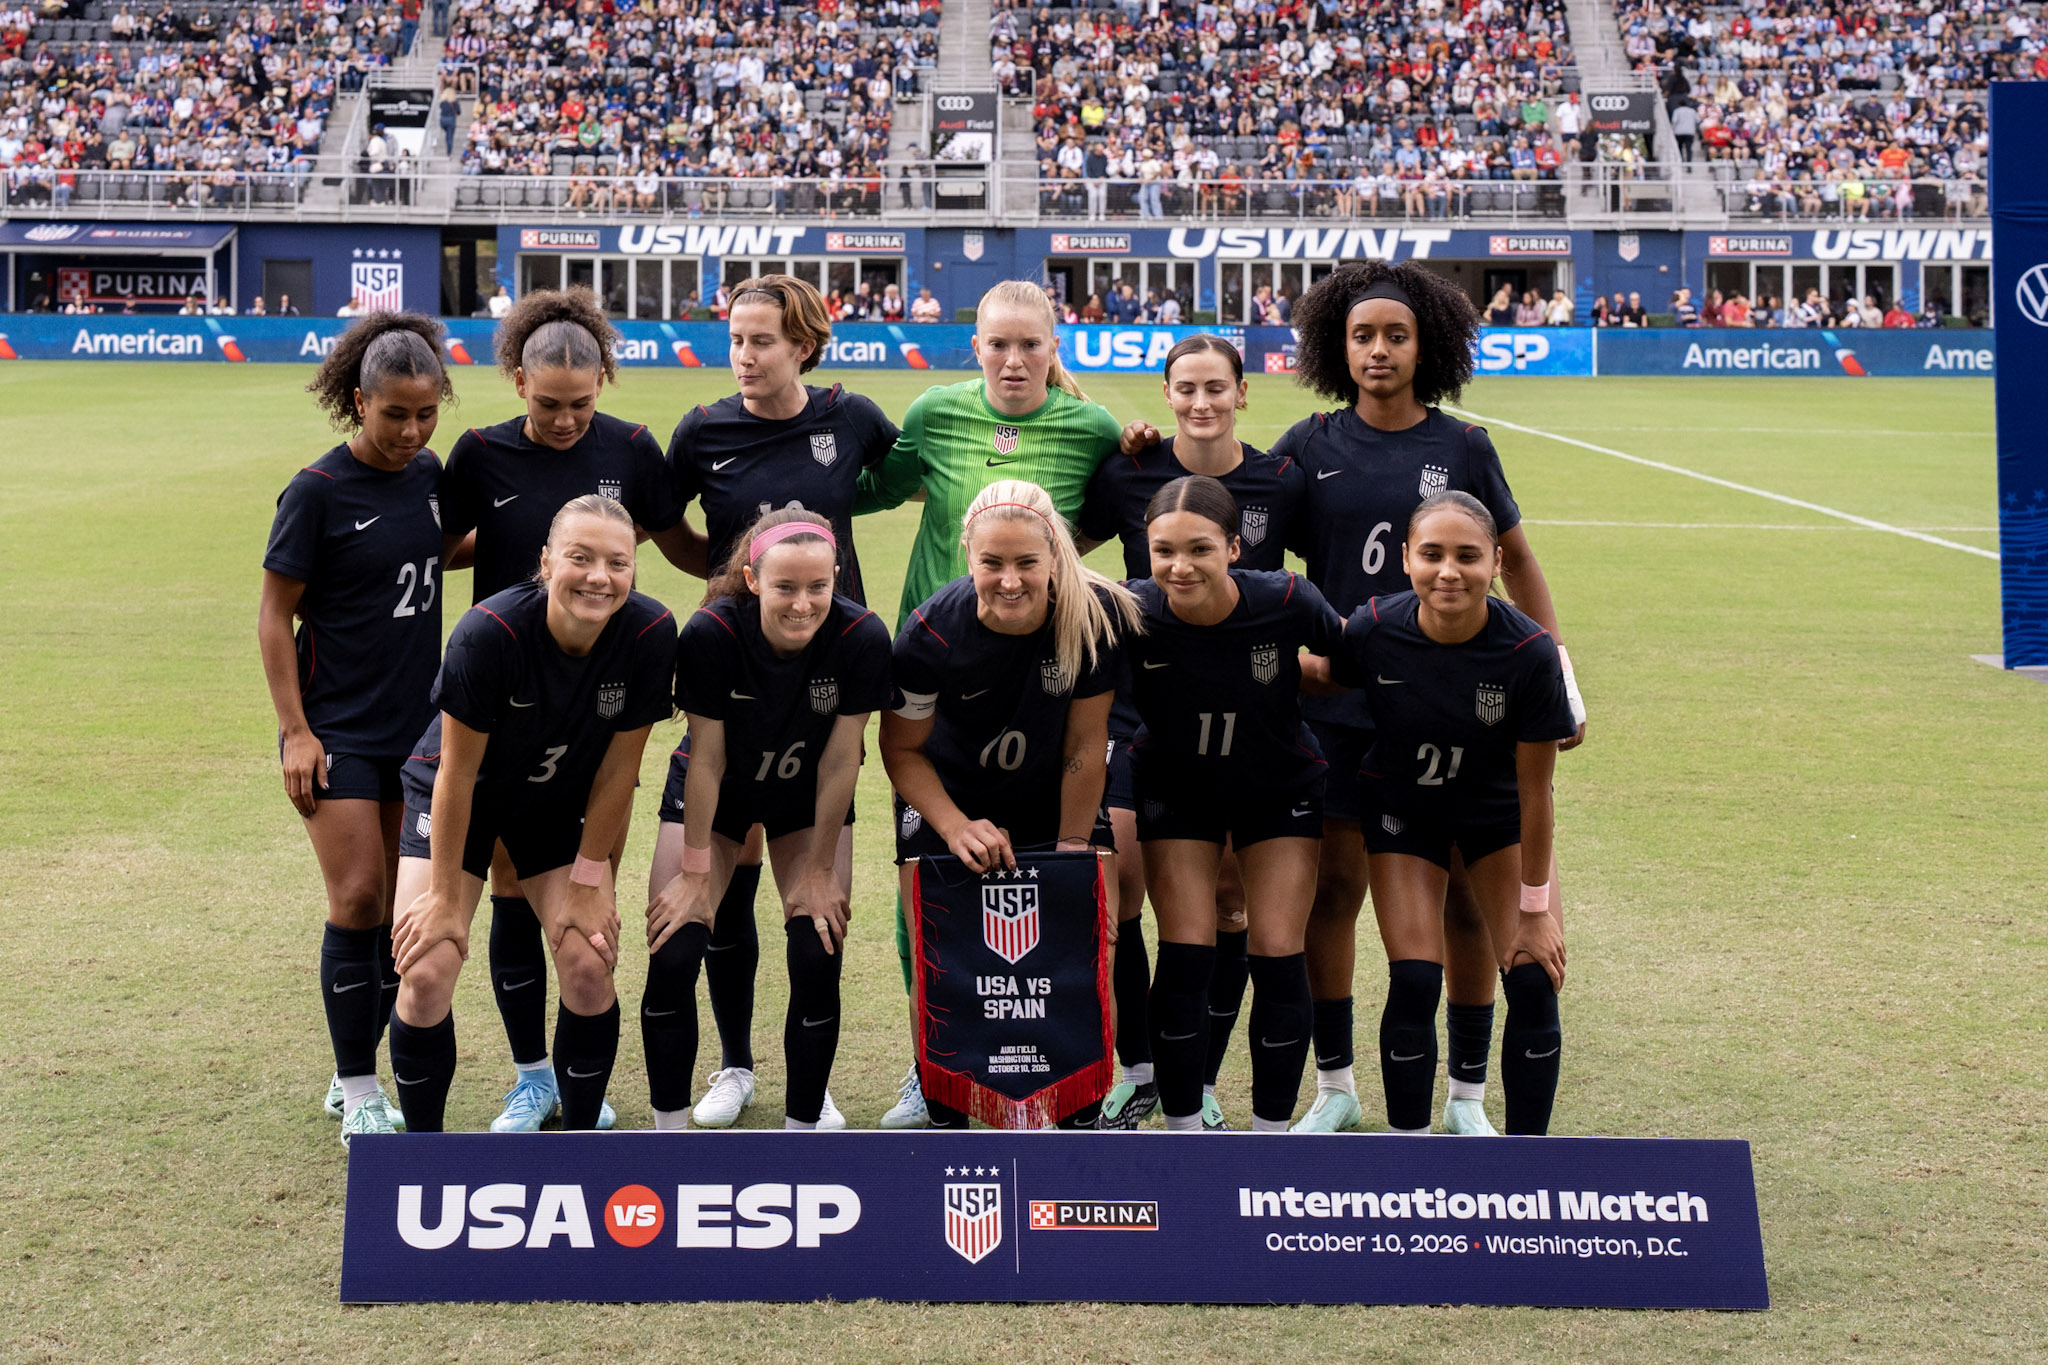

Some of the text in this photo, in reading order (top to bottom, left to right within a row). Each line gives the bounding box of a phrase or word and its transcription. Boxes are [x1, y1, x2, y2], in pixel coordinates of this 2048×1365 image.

[966, 120, 995, 130] Field
[1621, 120, 1651, 130] Field
[539, 232, 597, 246] PURINA
[617, 226, 807, 256] USWNT
[844, 235, 901, 248] PURINA
[1069, 236, 1128, 249] PURINA
[1167, 228, 1452, 261] USWNT
[1507, 238, 1568, 251] PURINA
[1727, 238, 1787, 251] PURINA
[96, 275, 208, 295] PURINA
[354, 267, 400, 292] USA
[71, 329, 204, 355] American
[820, 336, 887, 362] rican
[1075, 331, 1176, 367] USA
[1476, 333, 1550, 370] SP
[1682, 343, 1821, 369] American
[812, 436, 834, 450] USA
[996, 425, 1019, 439] USA
[1423, 472, 1446, 488] USA
[1244, 513, 1268, 528] USA
[1361, 521, 1393, 576] 6
[393, 555, 439, 619] 25
[1253, 653, 1276, 669] USA
[600, 690, 624, 705] USA
[811, 686, 836, 701] USA
[1479, 691, 1503, 706] USA
[1197, 712, 1237, 757] 11
[979, 726, 1027, 771] 10
[526, 744, 569, 783] 3
[754, 741, 806, 782] 16
[1416, 742, 1464, 786] 21
[985, 887, 1037, 918] USA
[976, 975, 1052, 996] USA VS
[983, 998, 1046, 1020] SPAIN
[1000, 1045, 1037, 1054] AUDI FIELD
[988, 1064, 1020, 1073] OCTOBER
[1031, 1064, 1050, 1073] 2026
[948, 1188, 998, 1217] USA
[1238, 1187, 1709, 1222] International Match
[397, 1183, 595, 1250] USA
[677, 1183, 862, 1249] ESP
[1265, 1233, 1688, 1258] October 10, 2026 Washington, D.C.
